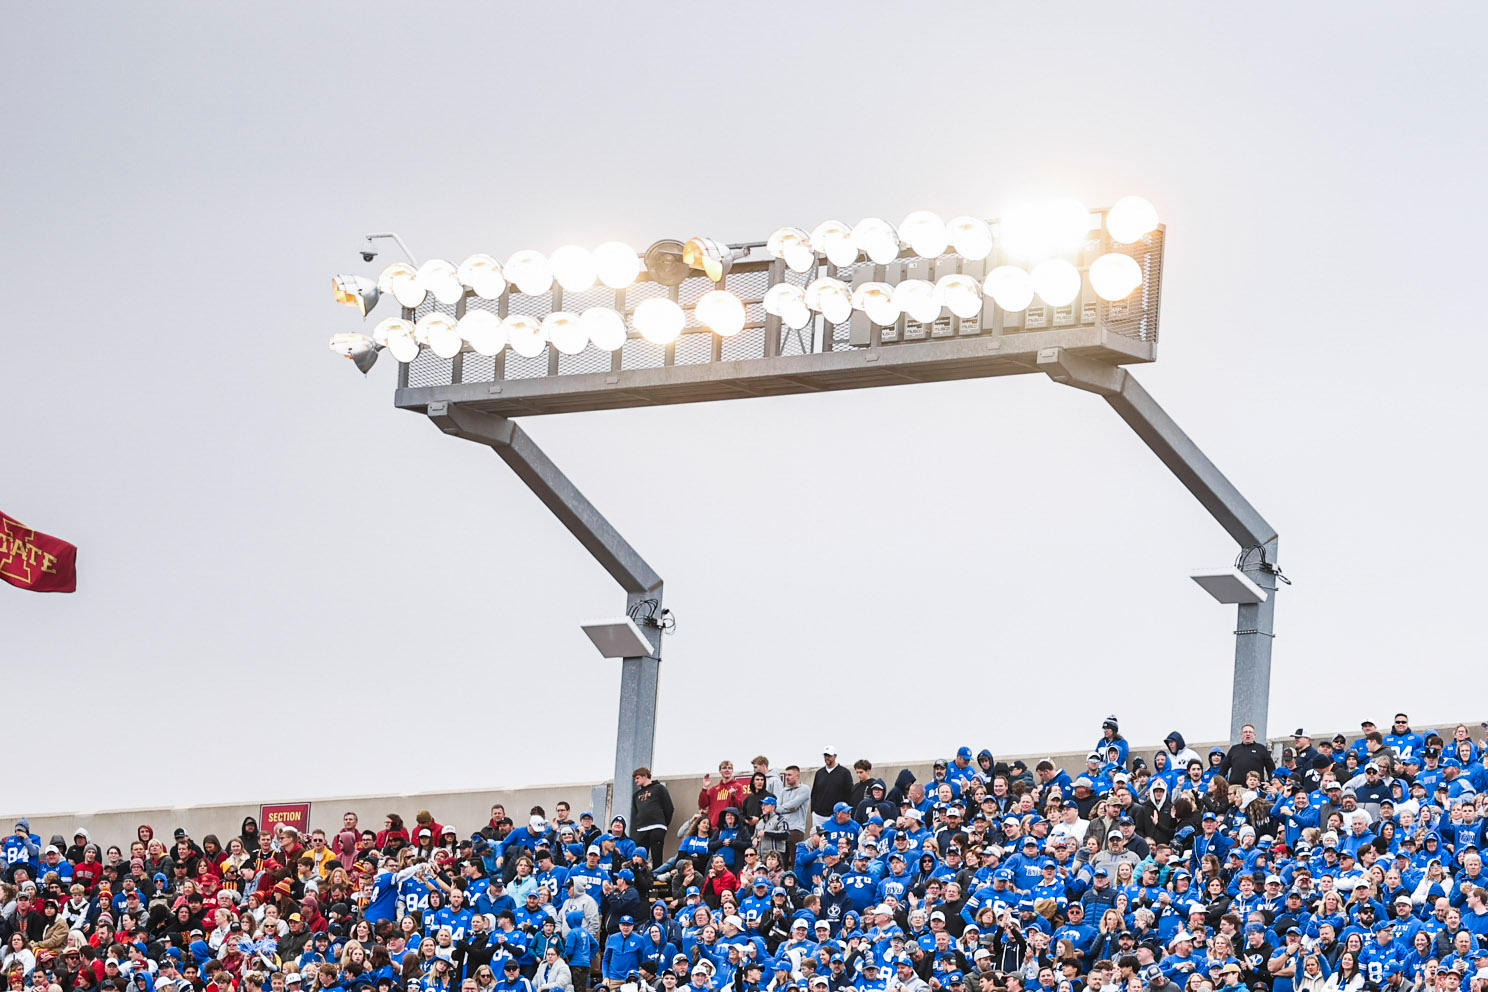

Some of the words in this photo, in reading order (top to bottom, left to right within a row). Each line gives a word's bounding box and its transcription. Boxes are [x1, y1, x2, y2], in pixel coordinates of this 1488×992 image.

[268, 812, 301, 822] SECTION
[830, 832, 854, 841] BYU
[7, 847, 29, 864] 84
[846, 876, 872, 885] BYU
[886, 886, 901, 894] BYU
[406, 894, 429, 912] 84
